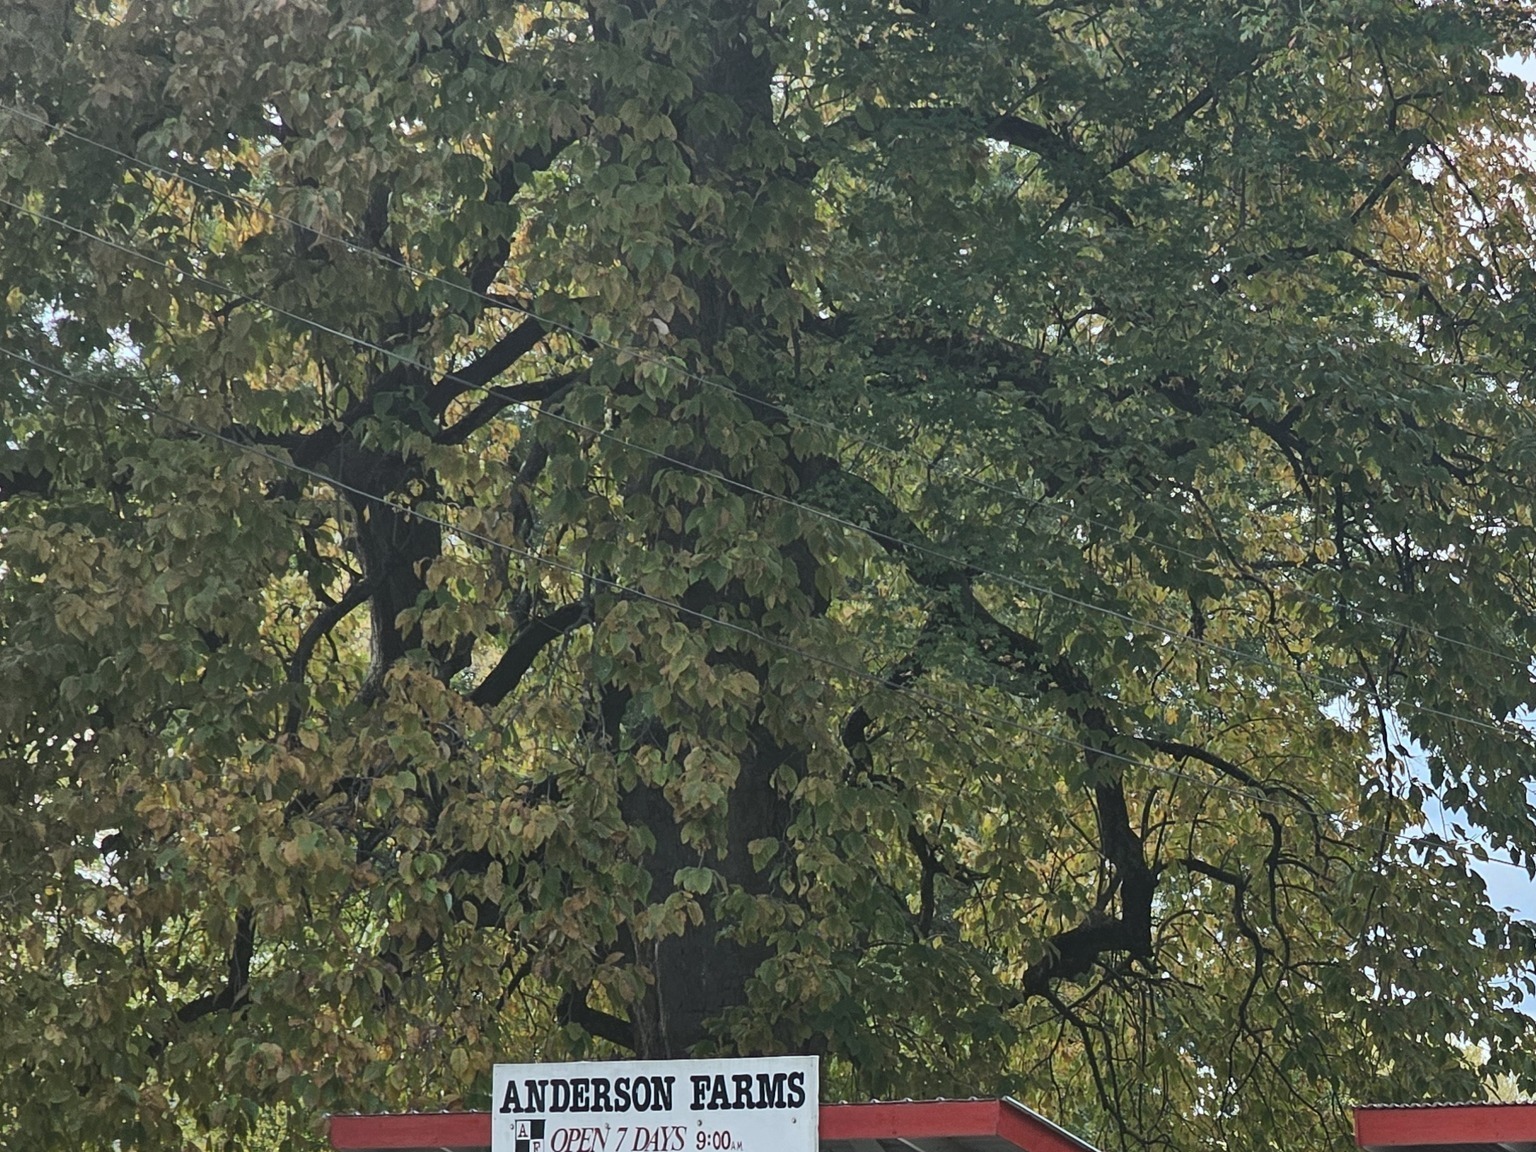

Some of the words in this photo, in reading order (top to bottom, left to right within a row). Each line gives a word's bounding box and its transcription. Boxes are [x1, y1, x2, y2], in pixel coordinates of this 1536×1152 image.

[500, 1076, 676, 1113] ANDERSON
[690, 1072, 806, 1111] FARMS
[517, 1123, 529, 1138] A
[550, 1126, 609, 1152] OPEN
[615, 1127, 628, 1152] 7
[631, 1126, 687, 1152] DAYS
